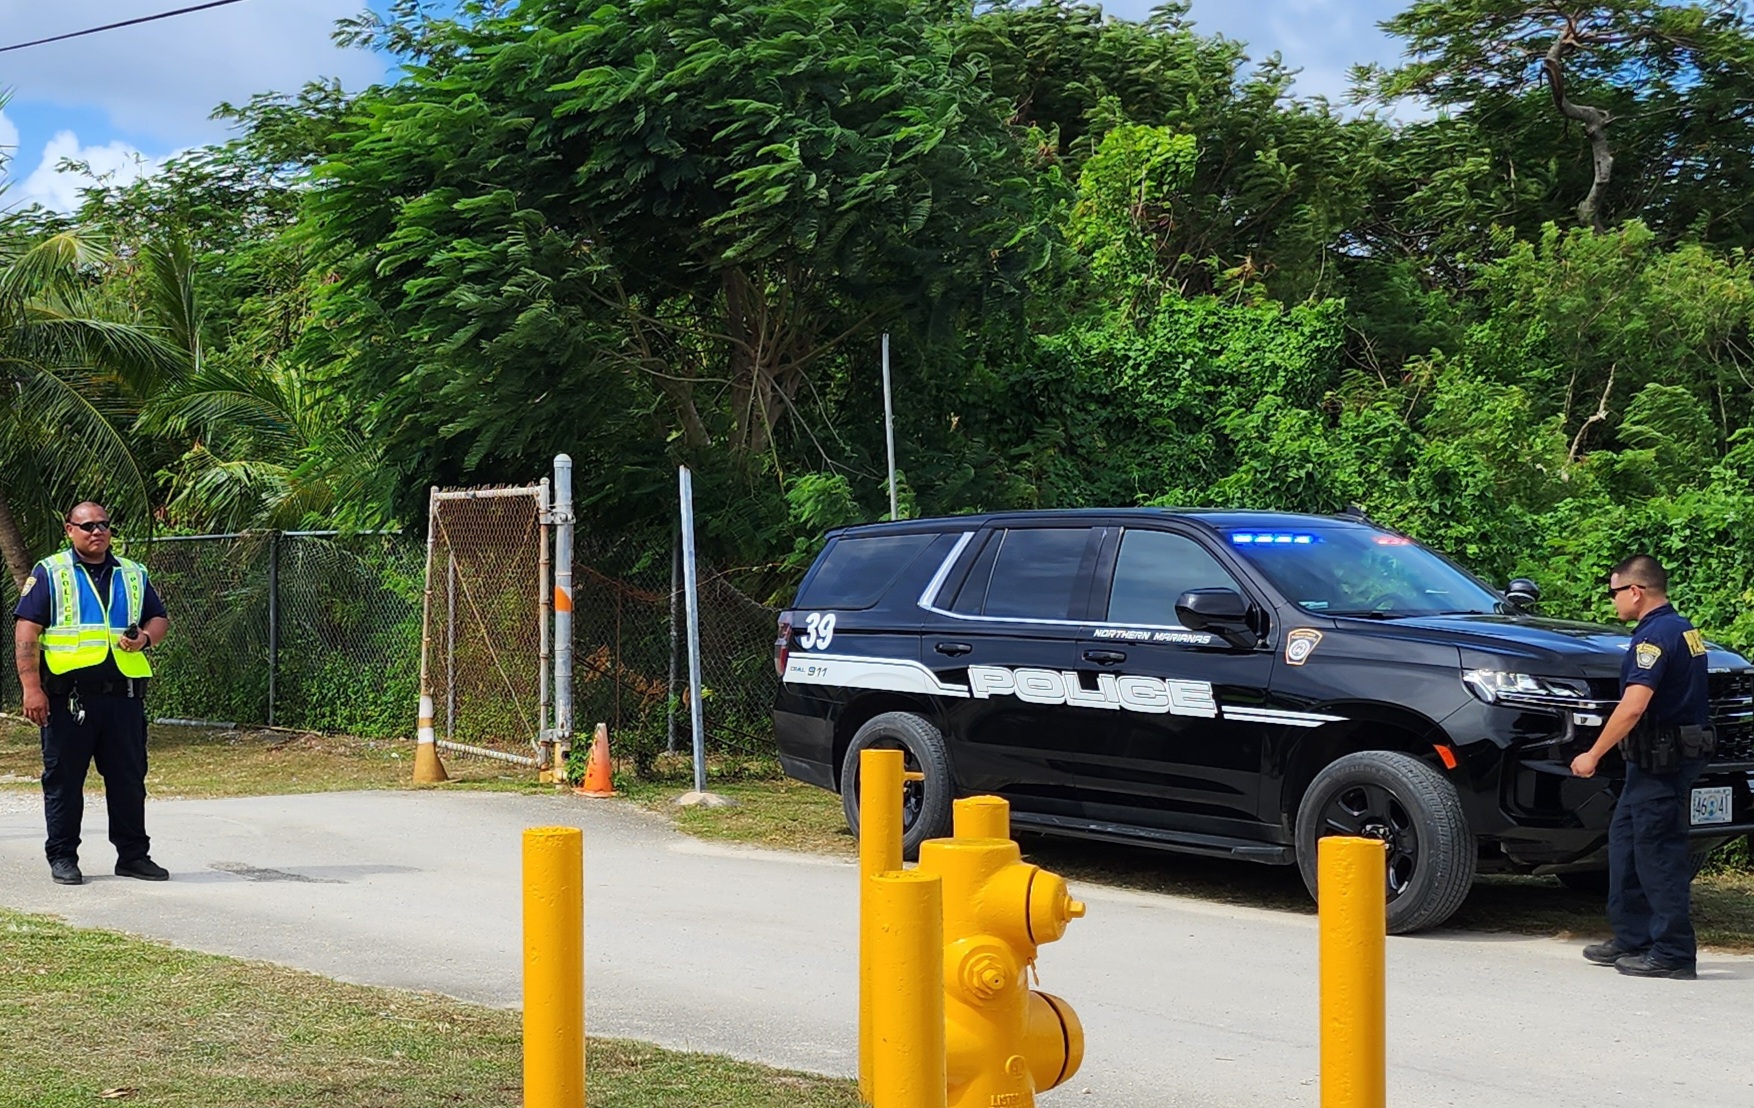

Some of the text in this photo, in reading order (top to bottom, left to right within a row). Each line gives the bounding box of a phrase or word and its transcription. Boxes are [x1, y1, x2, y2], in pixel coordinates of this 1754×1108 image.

[61, 571, 72, 622] POLICE
[130, 576, 138, 623] POLIC
[800, 612, 836, 650] 39
[1093, 629, 1211, 644] NORTHERN MARIANAS
[807, 666, 828, 677] 911
[968, 665, 1218, 718] POLICE
[990, 1092, 1025, 1106] LISTE
